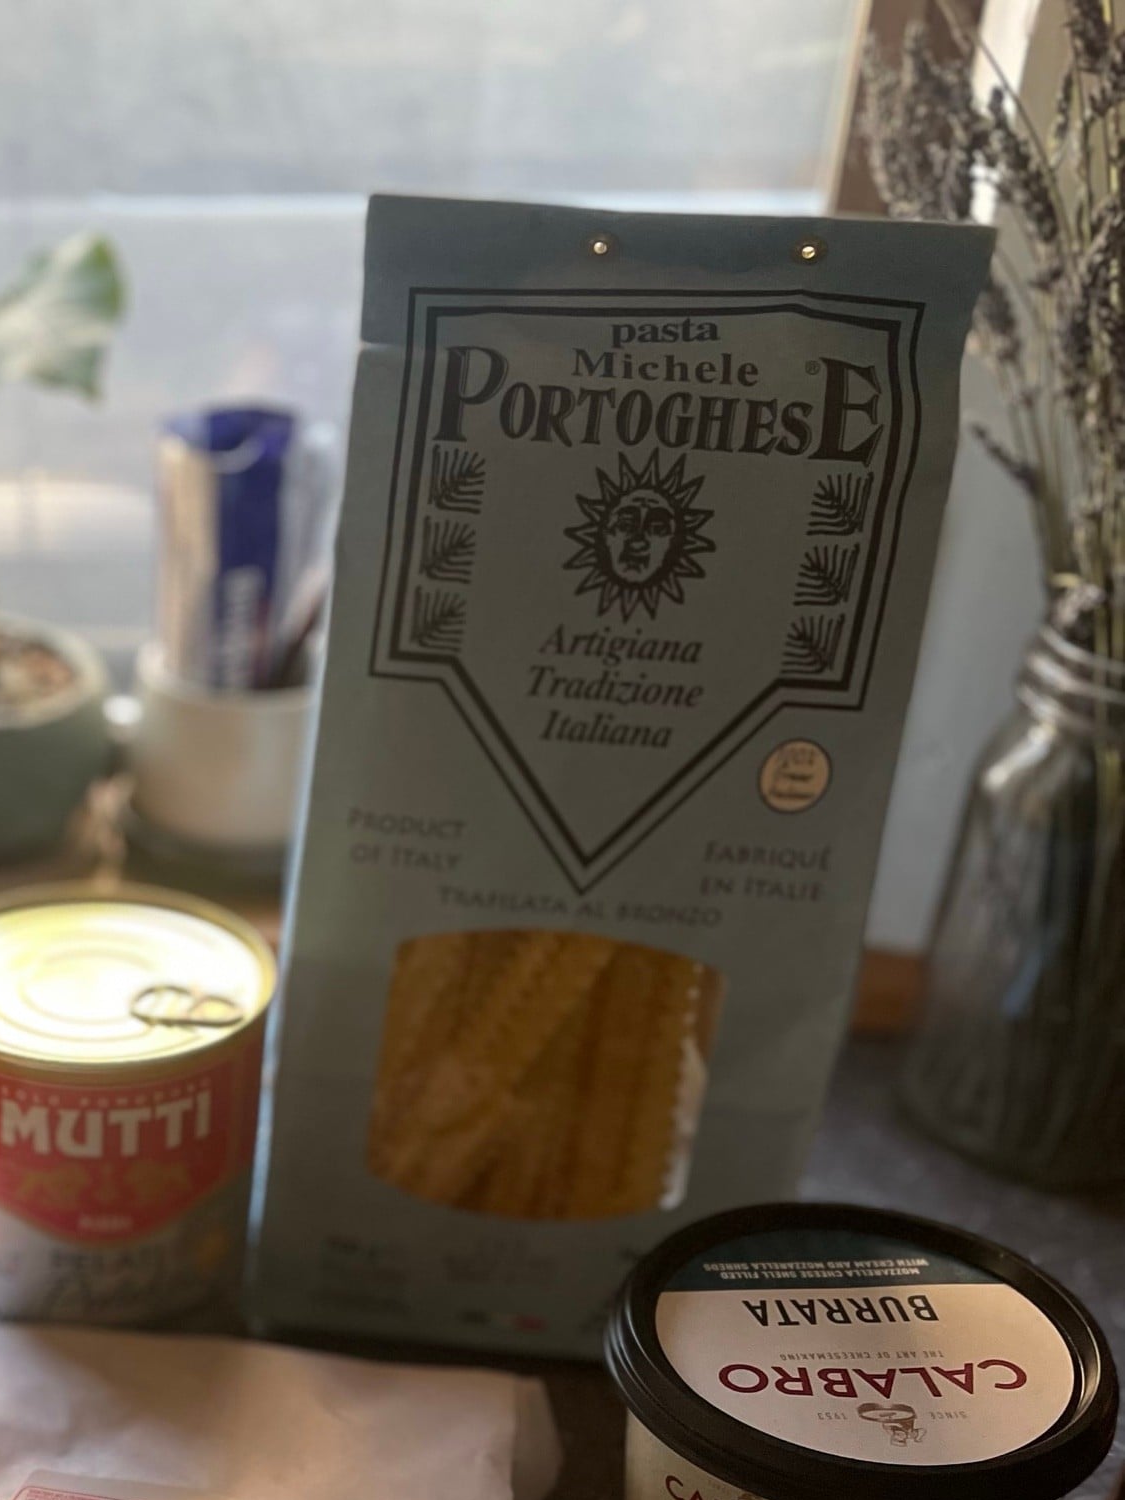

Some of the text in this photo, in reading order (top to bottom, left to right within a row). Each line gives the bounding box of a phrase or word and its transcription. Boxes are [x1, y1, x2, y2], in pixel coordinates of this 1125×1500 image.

[612, 318, 720, 348] pasta
[571, 348, 759, 386] Michele
[432, 346, 884, 468] PORTOGHESE
[538, 624, 703, 667] Artigiana
[528, 665, 704, 707] Tradizione
[540, 710, 672, 748] Italiana
[348, 808, 465, 839] PRODUCT
[350, 844, 462, 872] OF ITALY
[700, 876, 821, 902] EN ITALIE
[616, 902, 723, 927] BRONZO
[0, 1090, 211, 1157] MUTTI
[703, 1258, 930, 1271] WITH CREAM AND MOZZARELLA SHREDS
[720, 1267, 920, 1280] MOZZARELLA CHEESE SHELL FILLED
[742, 1295, 939, 1326] BURRATA
[780, 1349, 944, 1361] THE ART OF CHEESEMAKING
[718, 1359, 1027, 1399] CALABRO
[930, 1410, 967, 1420] SINCE
